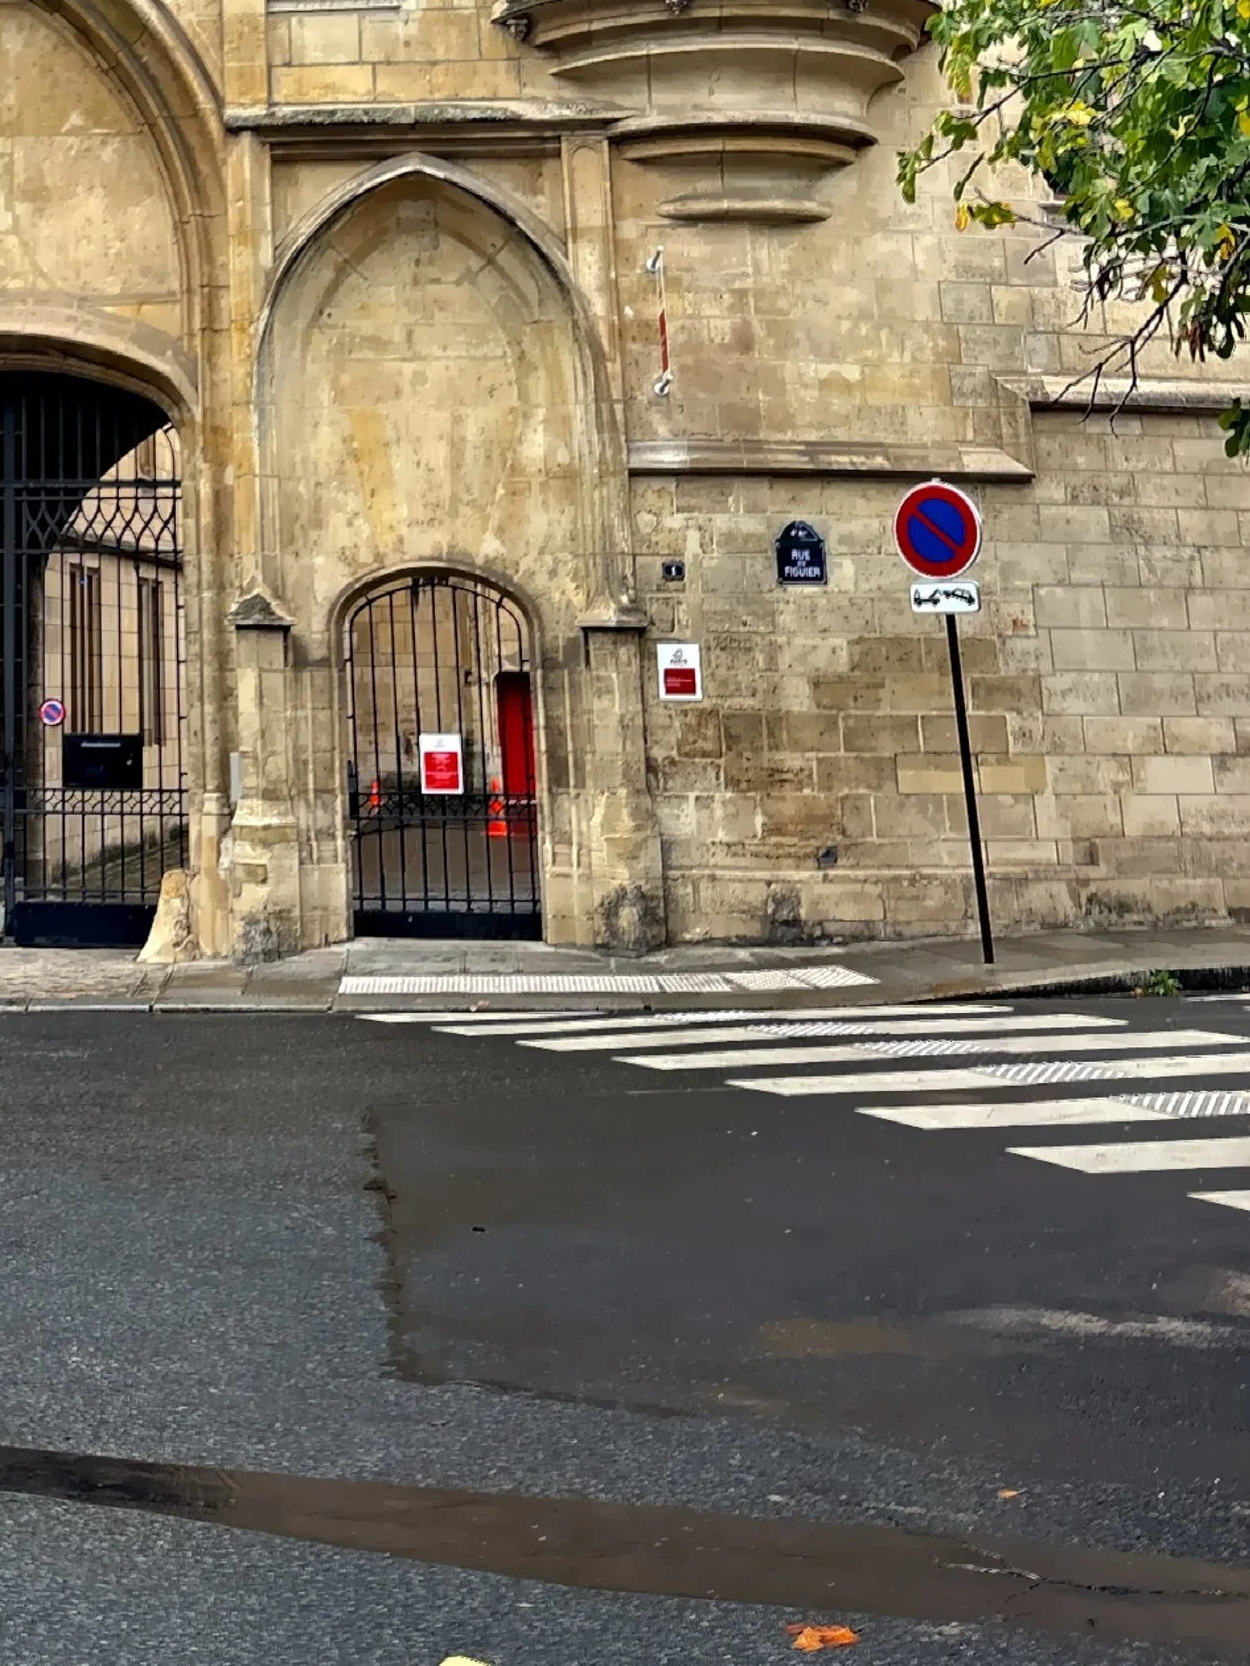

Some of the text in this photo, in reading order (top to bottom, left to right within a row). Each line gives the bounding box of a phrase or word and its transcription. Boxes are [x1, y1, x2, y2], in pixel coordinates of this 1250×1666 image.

[791, 548, 811, 562] RUE
[670, 566, 677, 576] 1
[784, 565, 821, 578] FIGUIER
